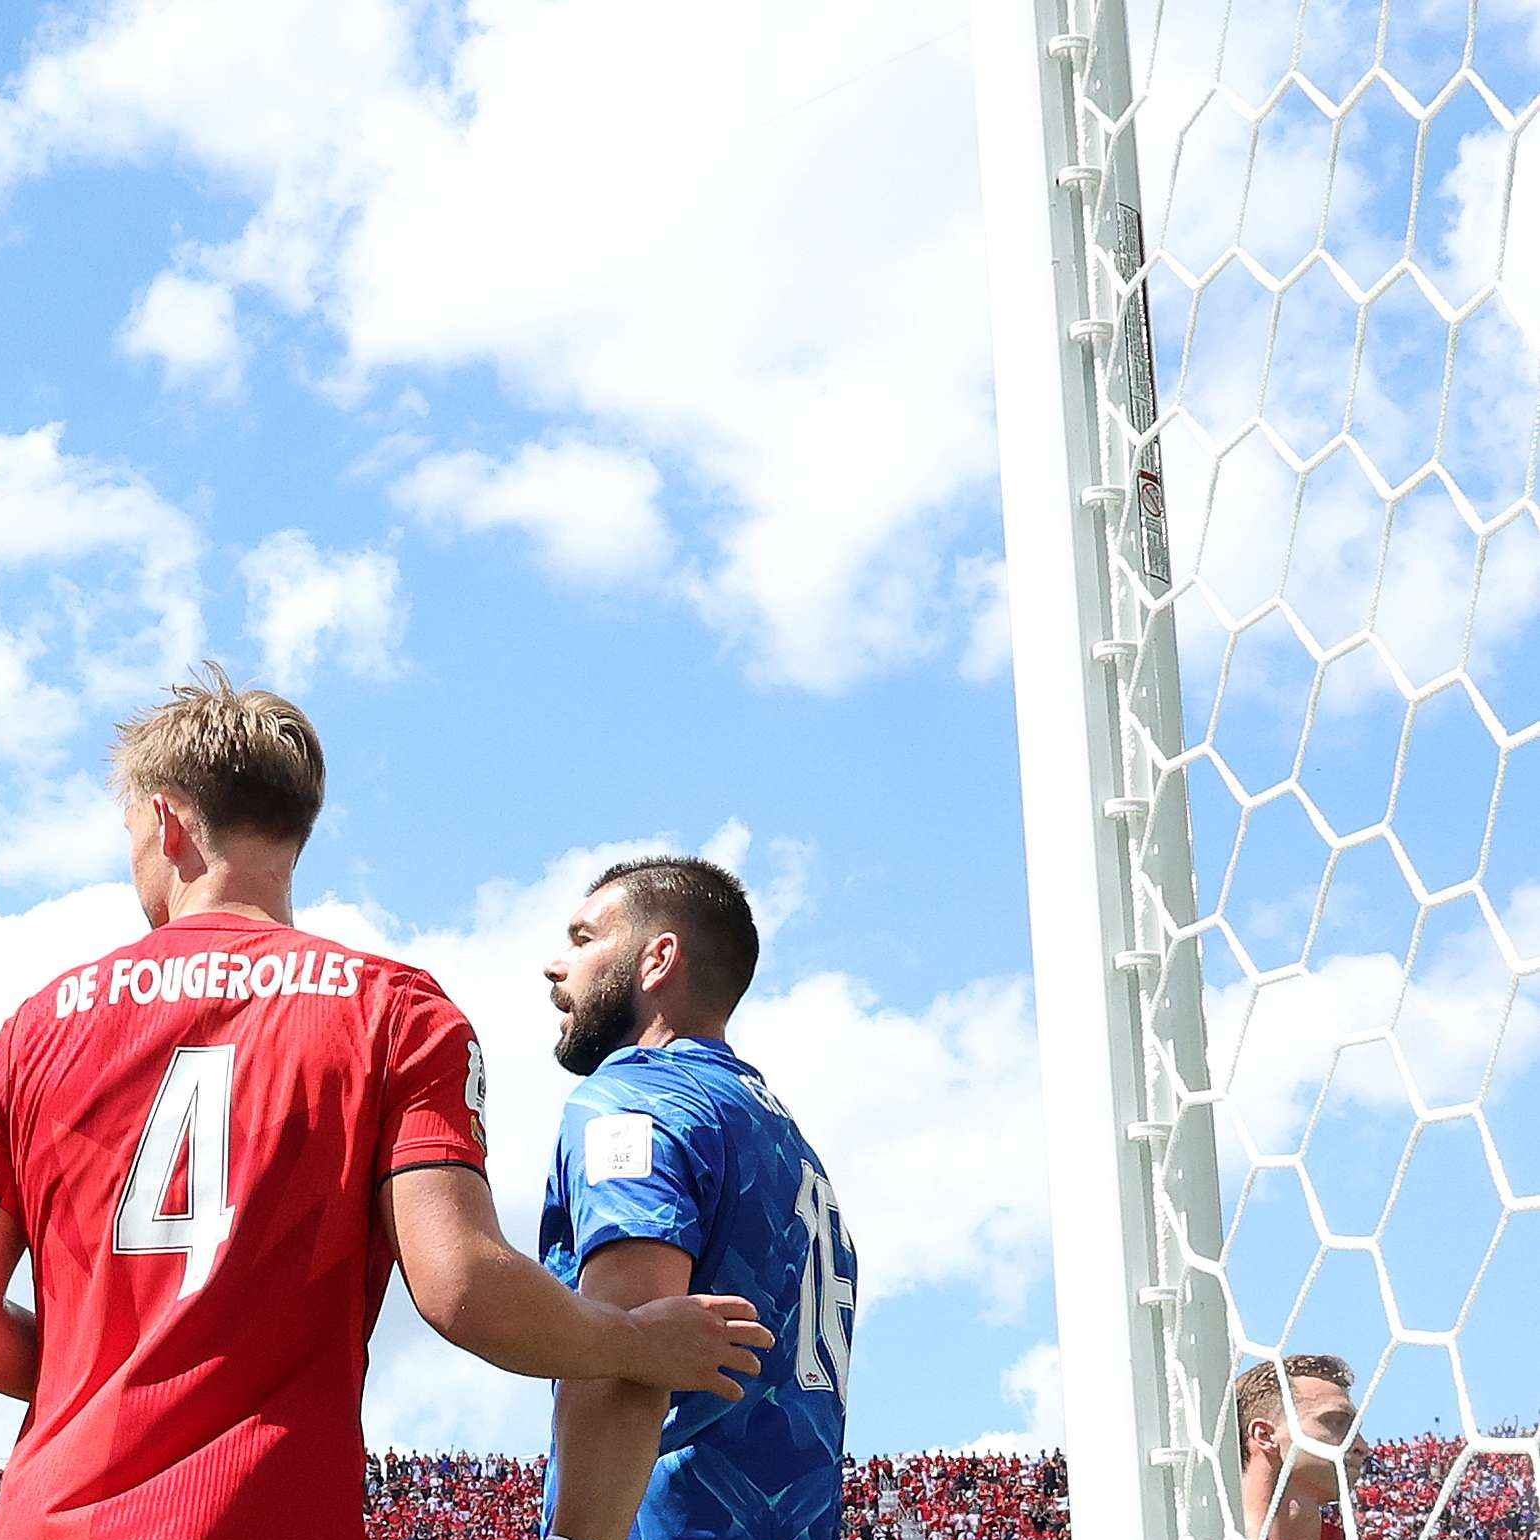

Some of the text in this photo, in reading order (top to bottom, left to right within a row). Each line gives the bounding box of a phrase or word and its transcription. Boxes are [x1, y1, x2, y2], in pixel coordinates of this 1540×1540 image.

[56, 950, 364, 1019] DE FOUGEROLLES
[112, 1043, 237, 1301] 4
